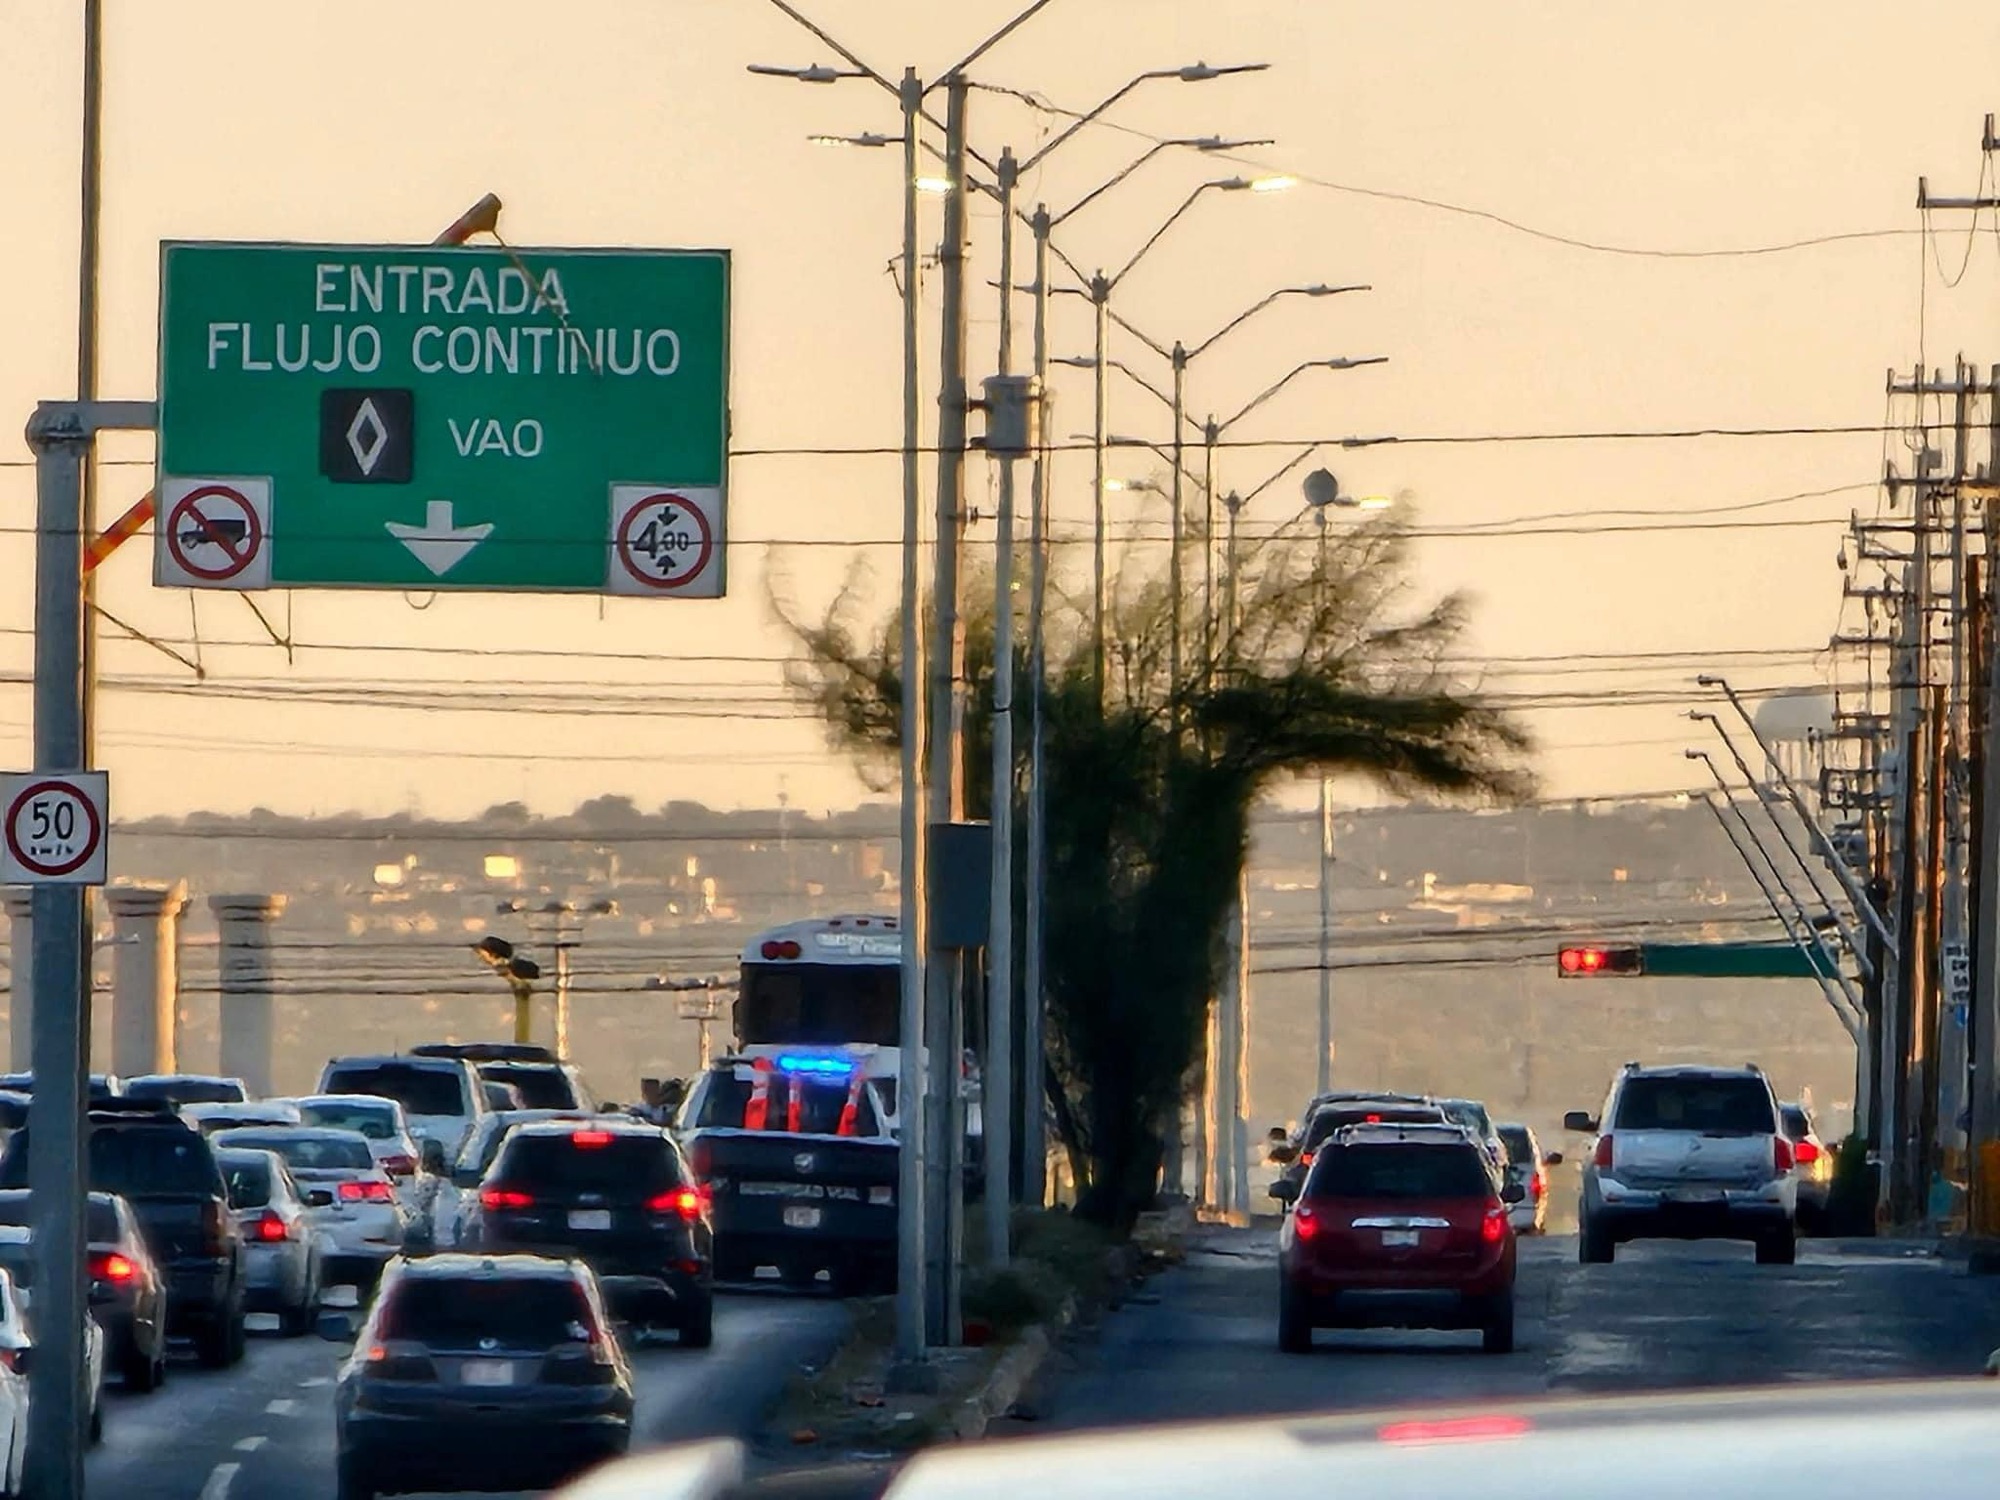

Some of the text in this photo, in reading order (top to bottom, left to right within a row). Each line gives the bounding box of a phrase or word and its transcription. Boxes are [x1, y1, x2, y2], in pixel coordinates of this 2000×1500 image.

[315, 264, 570, 315] ENTRADA
[207, 322, 681, 376] FLUJO CONTINUO
[448, 417, 544, 457] VAO
[32, 801, 74, 840] 50
